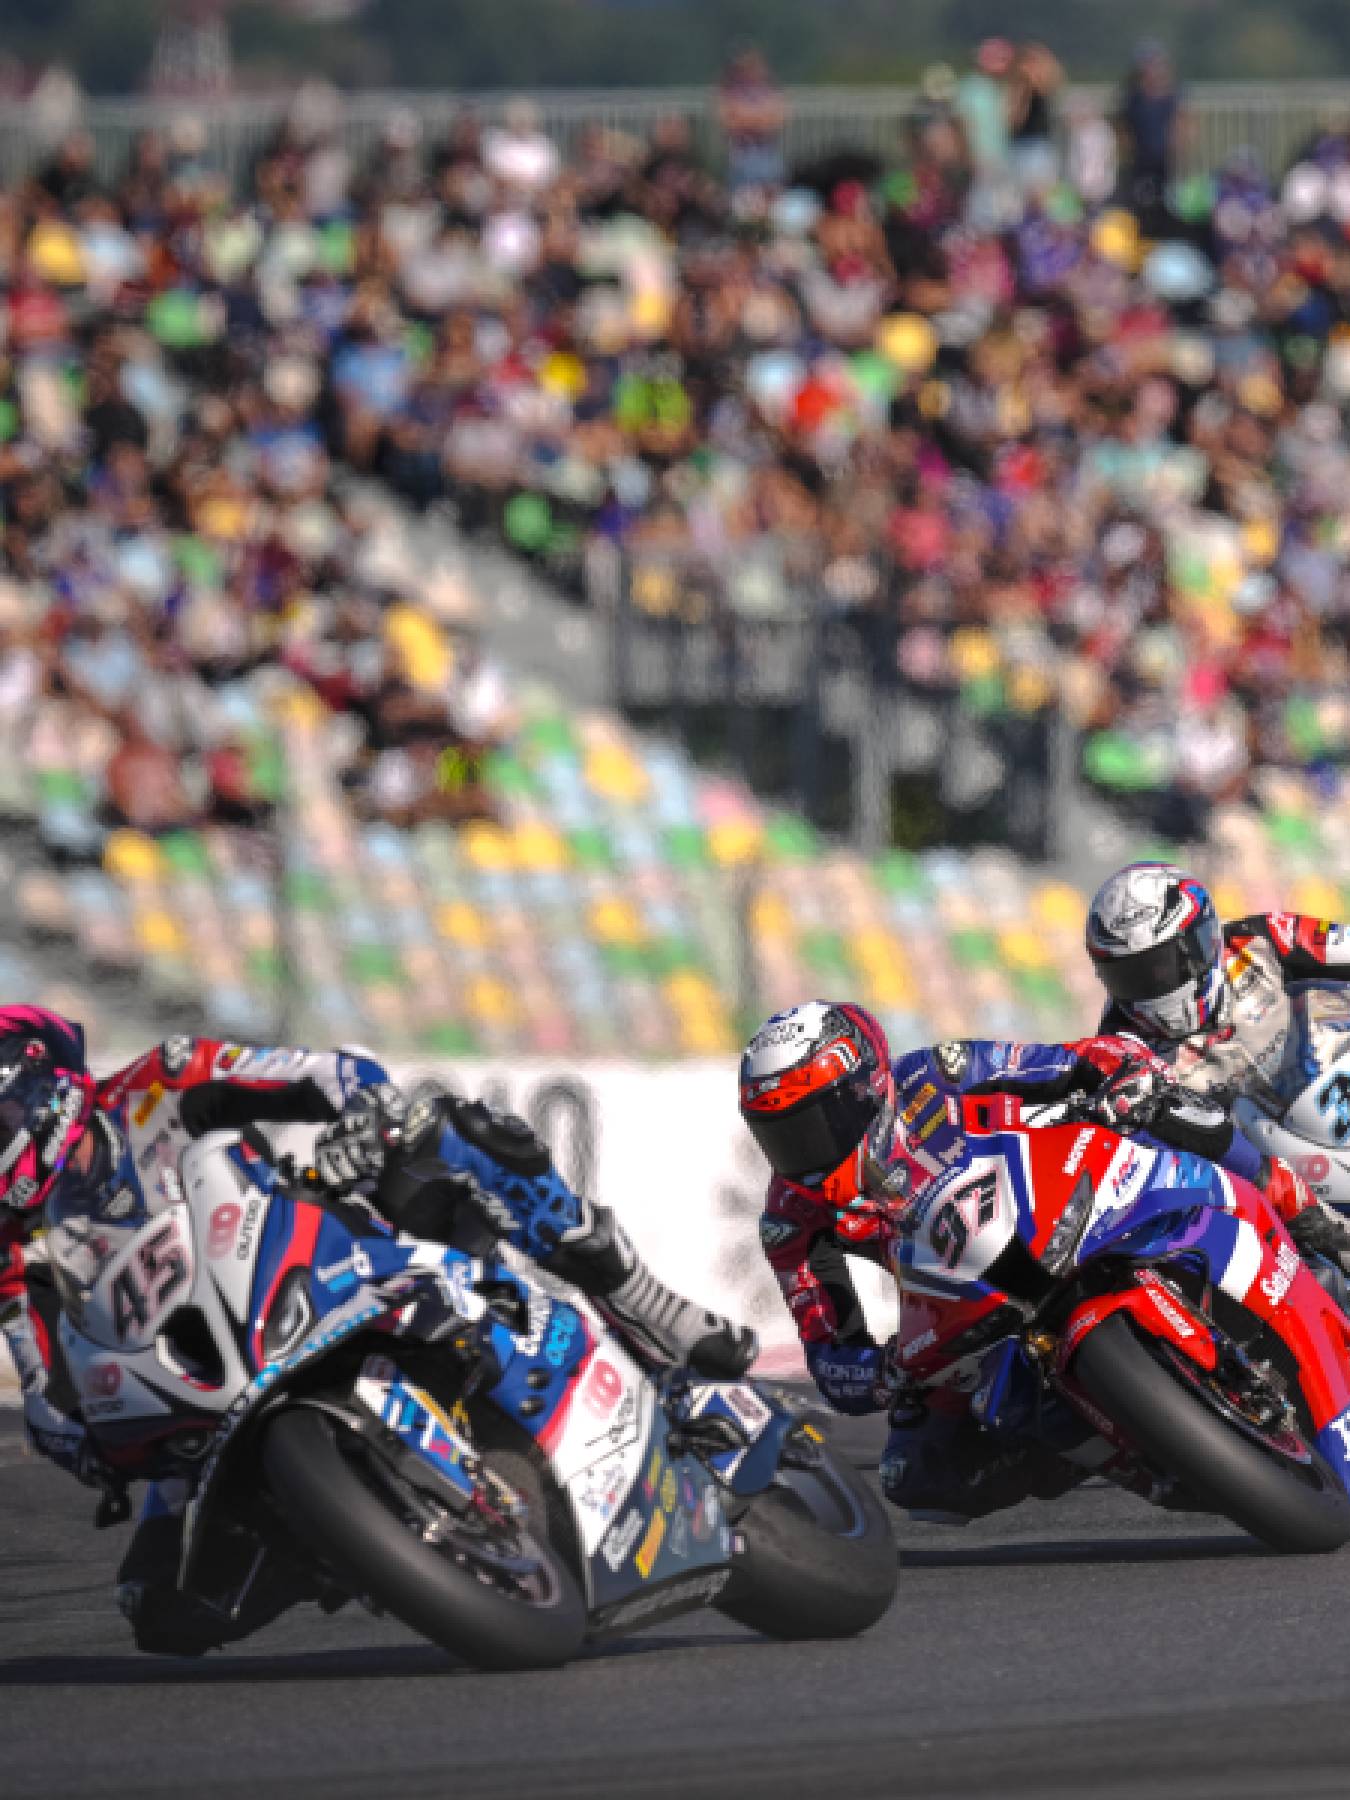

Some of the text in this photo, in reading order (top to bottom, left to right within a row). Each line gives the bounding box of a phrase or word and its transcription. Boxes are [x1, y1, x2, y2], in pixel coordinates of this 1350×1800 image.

[1062, 1128, 1096, 1176] MOTUL
[930, 1166, 999, 1271] 97
[110, 1220, 193, 1347] 45
